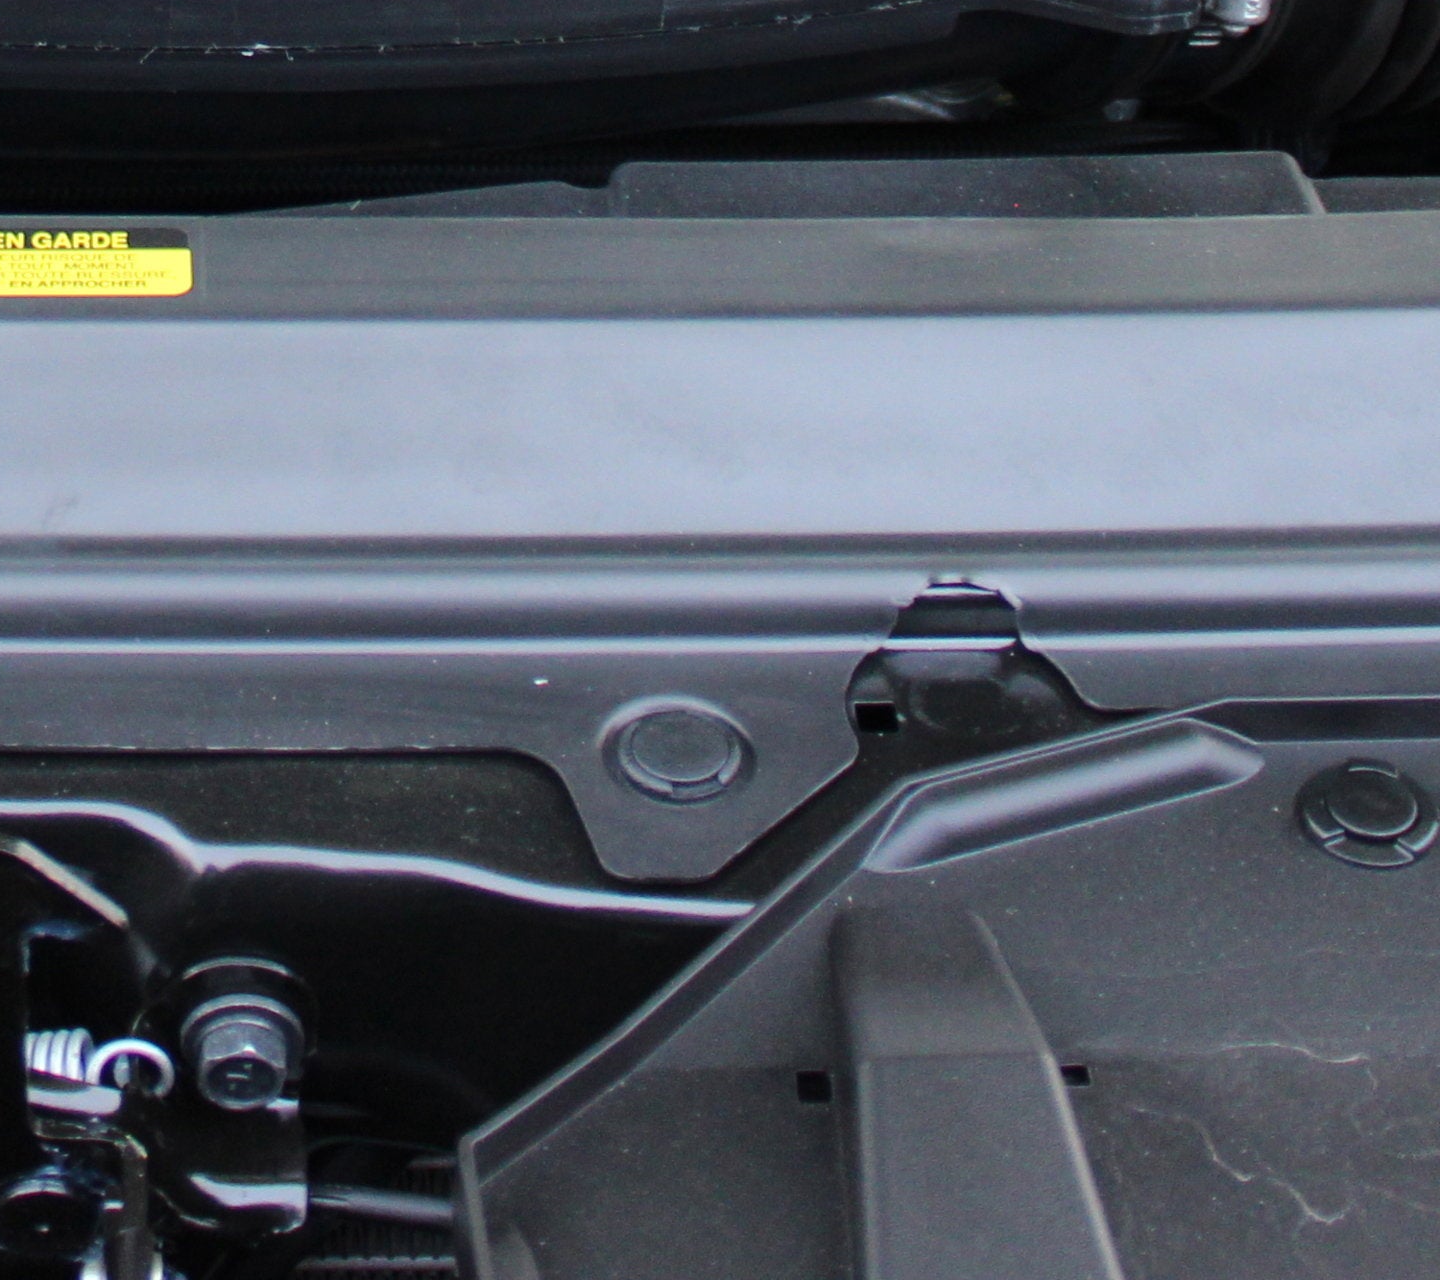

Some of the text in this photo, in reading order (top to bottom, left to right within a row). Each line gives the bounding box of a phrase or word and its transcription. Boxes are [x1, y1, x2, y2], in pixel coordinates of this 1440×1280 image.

[32, 231, 129, 249] GARDE
[41, 253, 106, 262] RISQUE
[114, 253, 136, 262] DE
[9, 262, 53, 270] TOUT
[64, 262, 135, 270] MOMENT
[13, 270, 67, 279] TOUTE
[38, 280, 147, 289] APPROCHER
